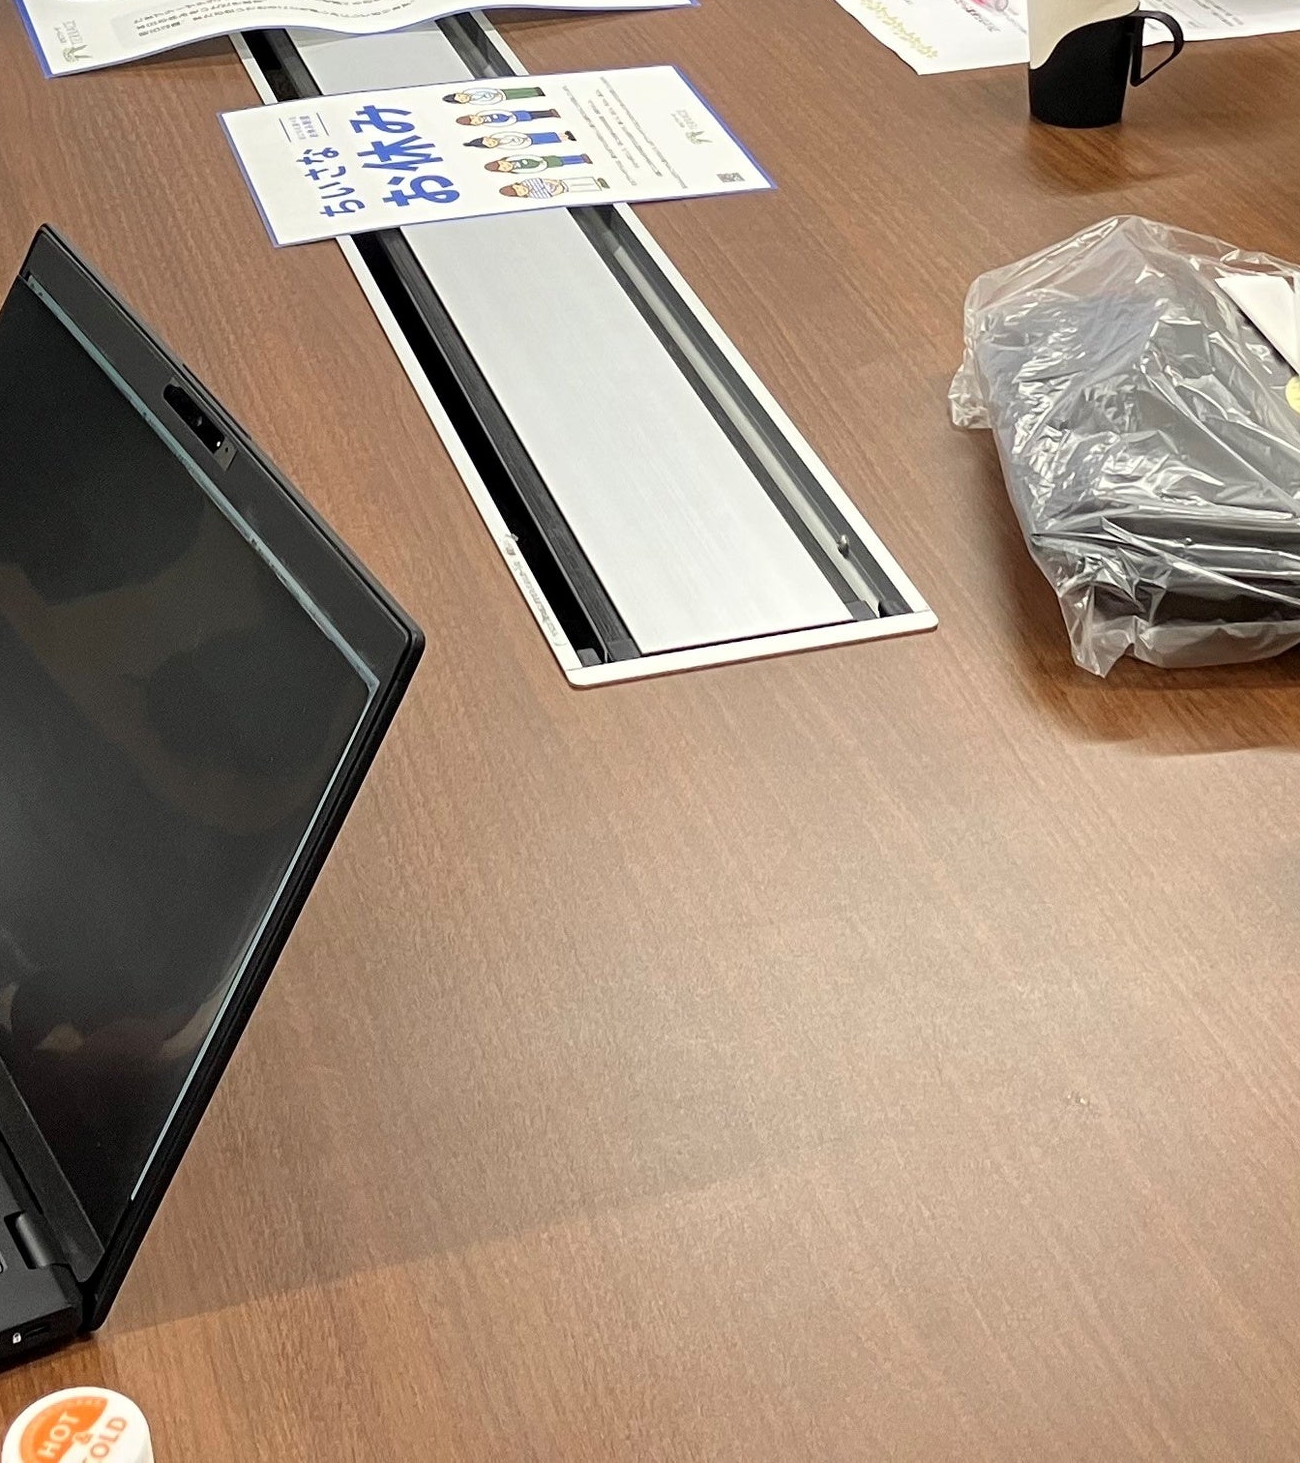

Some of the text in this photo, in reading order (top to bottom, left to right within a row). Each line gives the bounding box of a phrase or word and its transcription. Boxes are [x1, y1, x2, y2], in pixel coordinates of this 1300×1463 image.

[296, 147, 365, 217] ちいさな
[349, 104, 460, 207] お休み
[36, 1411, 78, 1457] HOT
[83, 1416, 127, 1463] OLD
